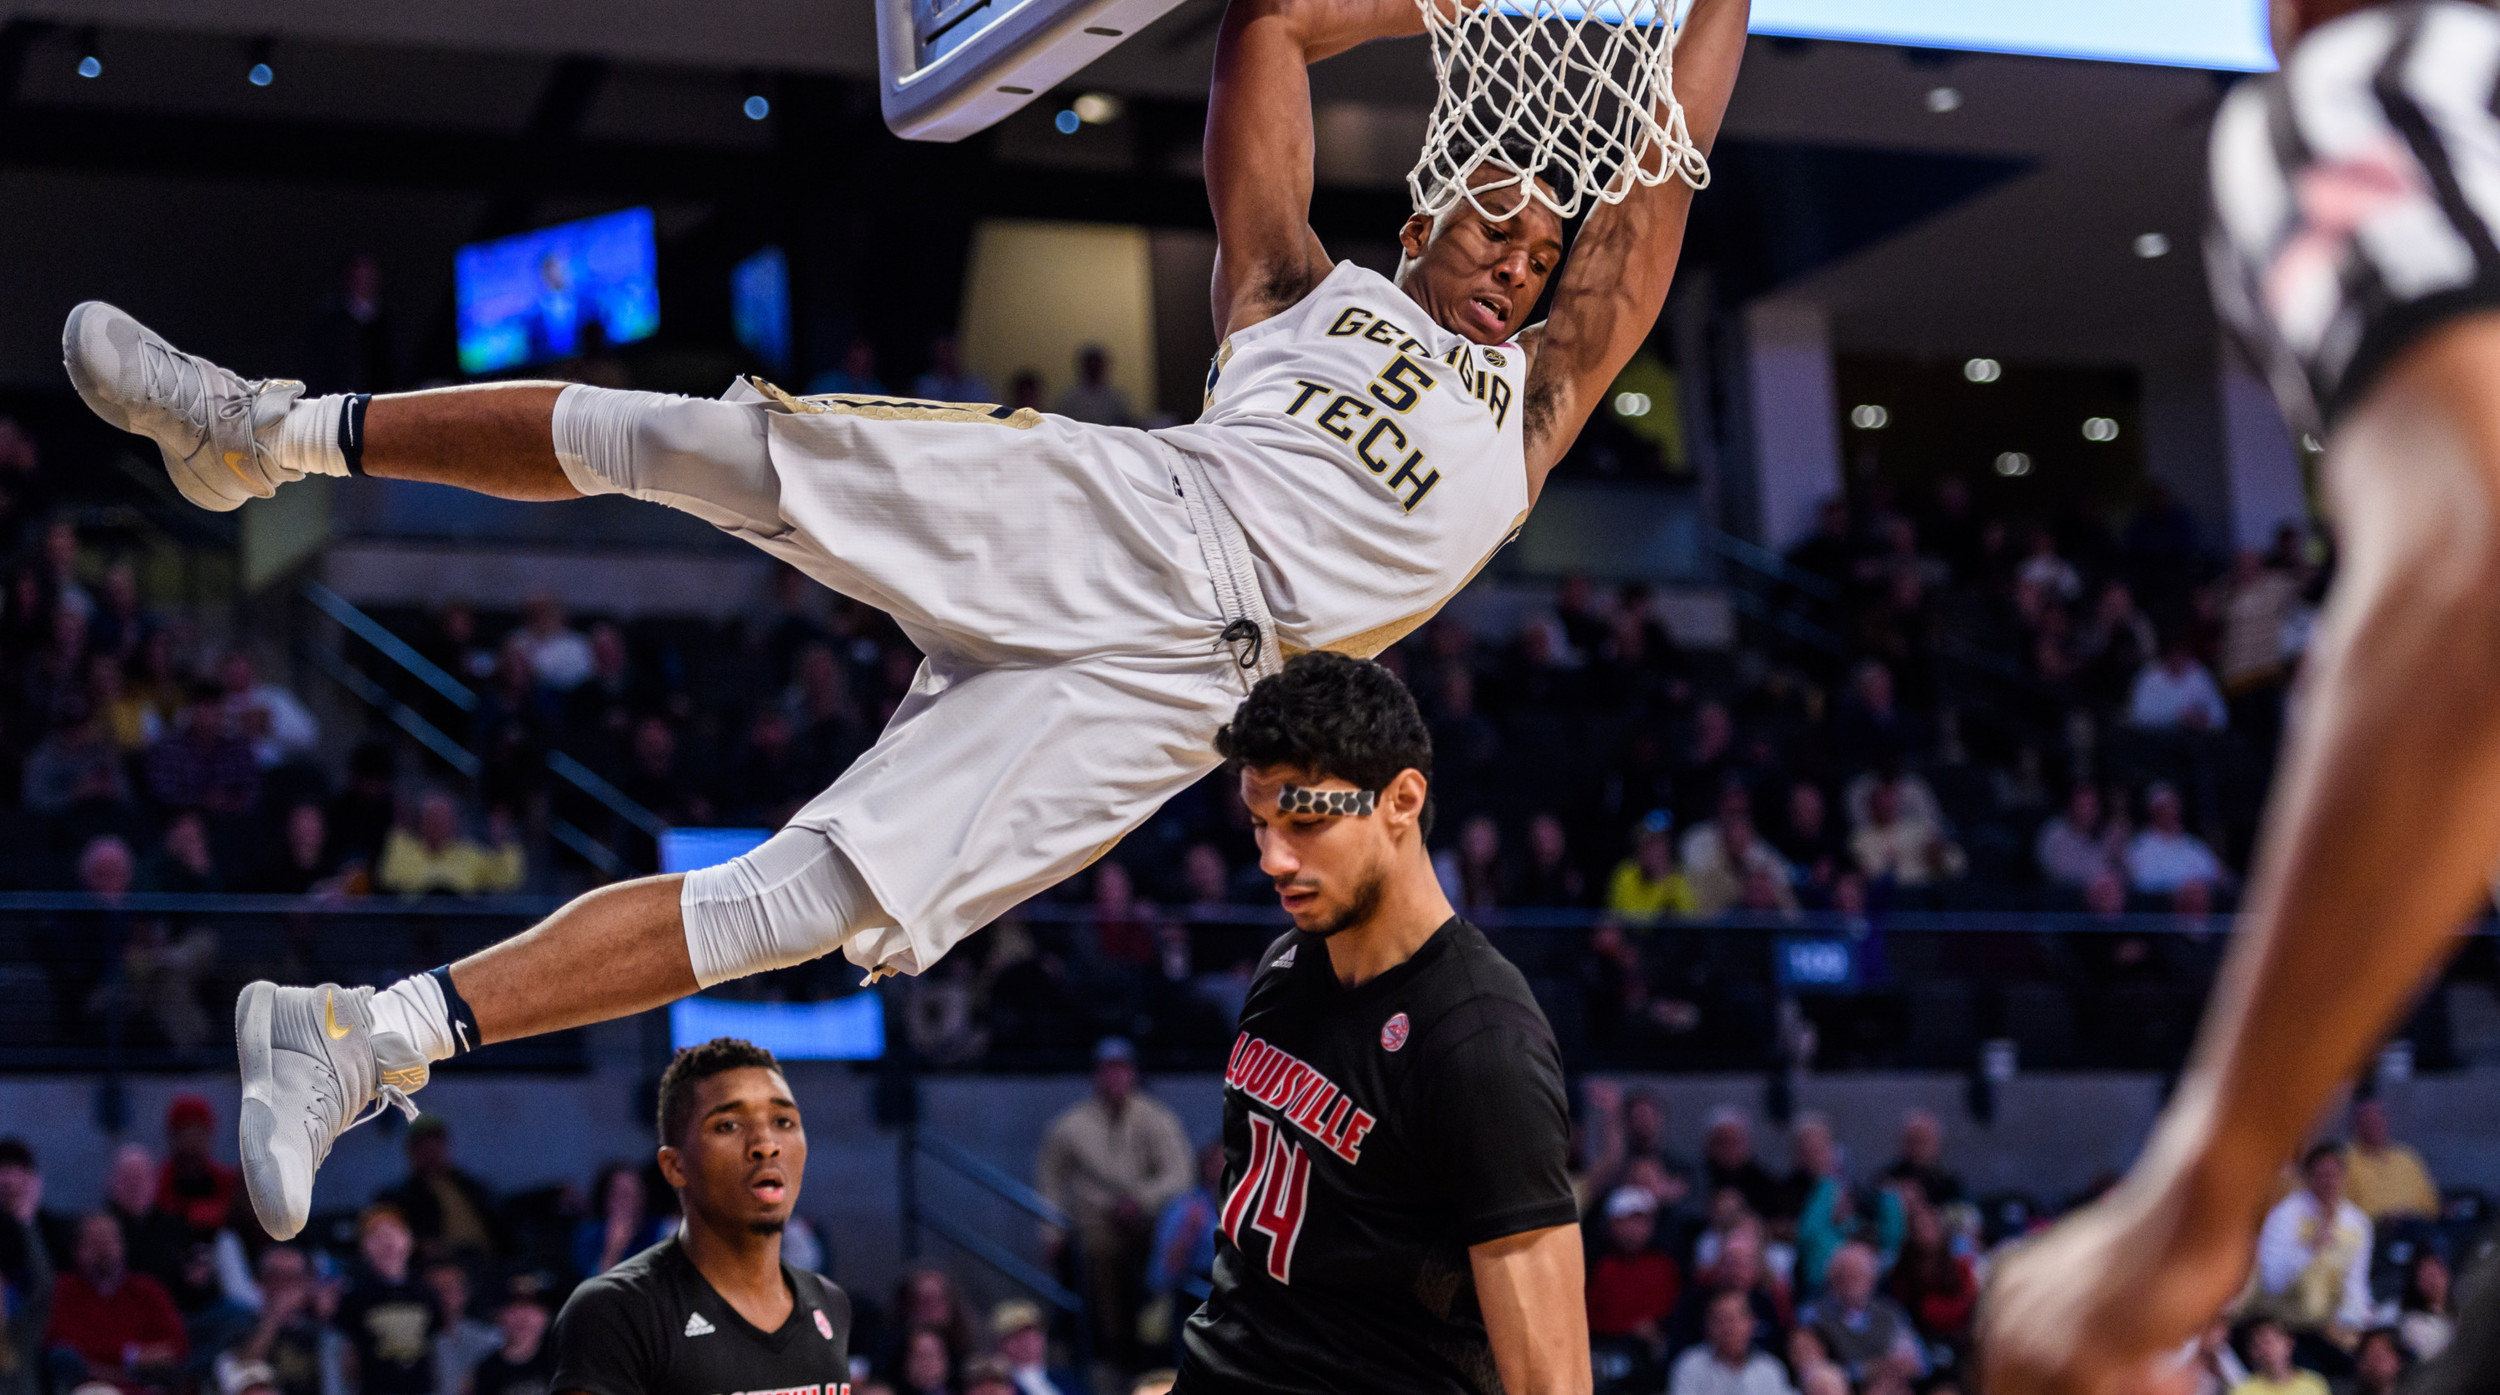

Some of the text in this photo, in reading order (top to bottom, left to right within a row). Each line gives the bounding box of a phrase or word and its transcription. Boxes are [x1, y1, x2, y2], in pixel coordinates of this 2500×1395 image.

[1284, 379, 1442, 516] TECH
[1366, 351, 1438, 415] 5
[1225, 1031, 1377, 1166] LOUISVILLE
[1221, 1110, 1311, 1285] 14
